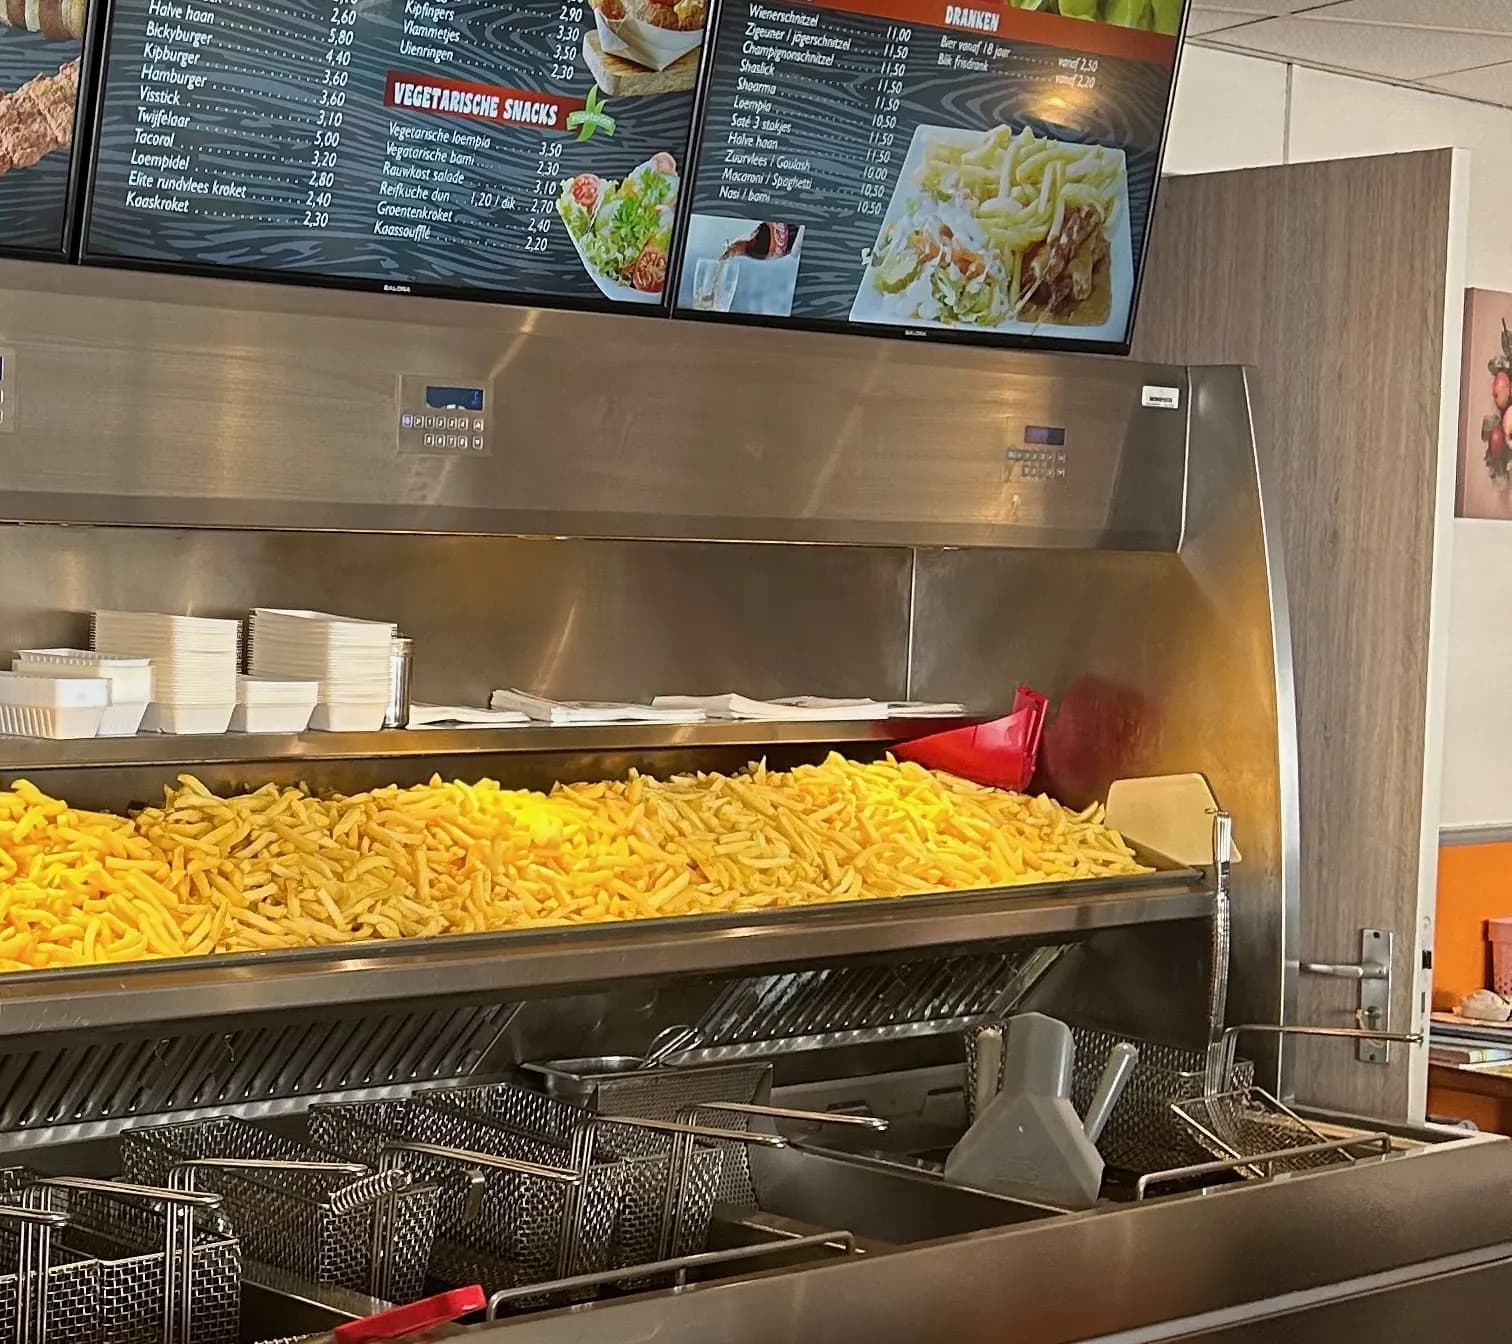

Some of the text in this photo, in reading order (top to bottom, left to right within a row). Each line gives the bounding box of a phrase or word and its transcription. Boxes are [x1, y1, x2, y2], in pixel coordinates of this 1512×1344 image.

[149, 0, 353, 46] Halve haan 5,80
[330, 8, 356, 25] 2,60
[405, 0, 579, 42] Kipfingers 3,30
[559, 5, 582, 22] 2,90
[750, 3, 911, 42] Wienerschnitzel 11,00
[945, 6, 999, 31] DRANKEN
[146, 21, 351, 66] Bickyburger 4,40
[404, 19, 577, 61] Vlammetjes 3,50
[884, 44, 908, 60] 11,50
[983, 42, 994, 55] 18
[1080, 58, 1098, 72] 2,50
[143, 43, 348, 86] Kipburger 3,60
[400, 39, 574, 80] Uienringen 2,30
[881, 62, 905, 77] 11,50
[141, 65, 345, 107] Hamburger 3,60
[736, 77, 900, 112] Shoarma 11,50
[878, 79, 902, 94] 11,50
[140, 86, 342, 127] Visstick 3,10
[394, 82, 499, 117] VEGETARISCHE
[503, 99, 558, 125] SNACKS
[733, 95, 896, 129] Loempia 10,50
[138, 108, 340, 148] Twijfelaar 5,00
[390, 121, 562, 157] Vegetarische loempia 3,50
[731, 113, 751, 128] Saté
[752, 116, 760, 129] 3
[869, 131, 894, 146] 11,50
[135, 128, 337, 167] Tacorol 3,20
[449, 150, 475, 166] bami
[536, 161, 559, 176] 2,30
[728, 132, 890, 163] Halve haan 11,50
[131, 150, 334, 187] Loempidel 2,80
[382, 161, 556, 195] Rauwkost salade 3,10
[725, 150, 768, 166] Zuurvlees
[776, 156, 810, 172] Goulash
[863, 165, 888, 180] 10,00
[129, 171, 331, 208] Elite rundvlees kroket 2,40
[431, 187, 450, 202] dun
[471, 191, 492, 207] 1,20
[531, 199, 553, 214] 2,70
[719, 186, 740, 199] Nasi
[748, 189, 771, 203] bami
[857, 200, 882, 215] 10,50
[772, 173, 812, 191] Spaghetti
[860, 183, 885, 198] 10,50
[126, 193, 328, 227] Kaaskroket 2,30
[377, 200, 550, 233] Groentenkroket 2,40
[374, 220, 547, 251] Kaassoufflé 2,20
